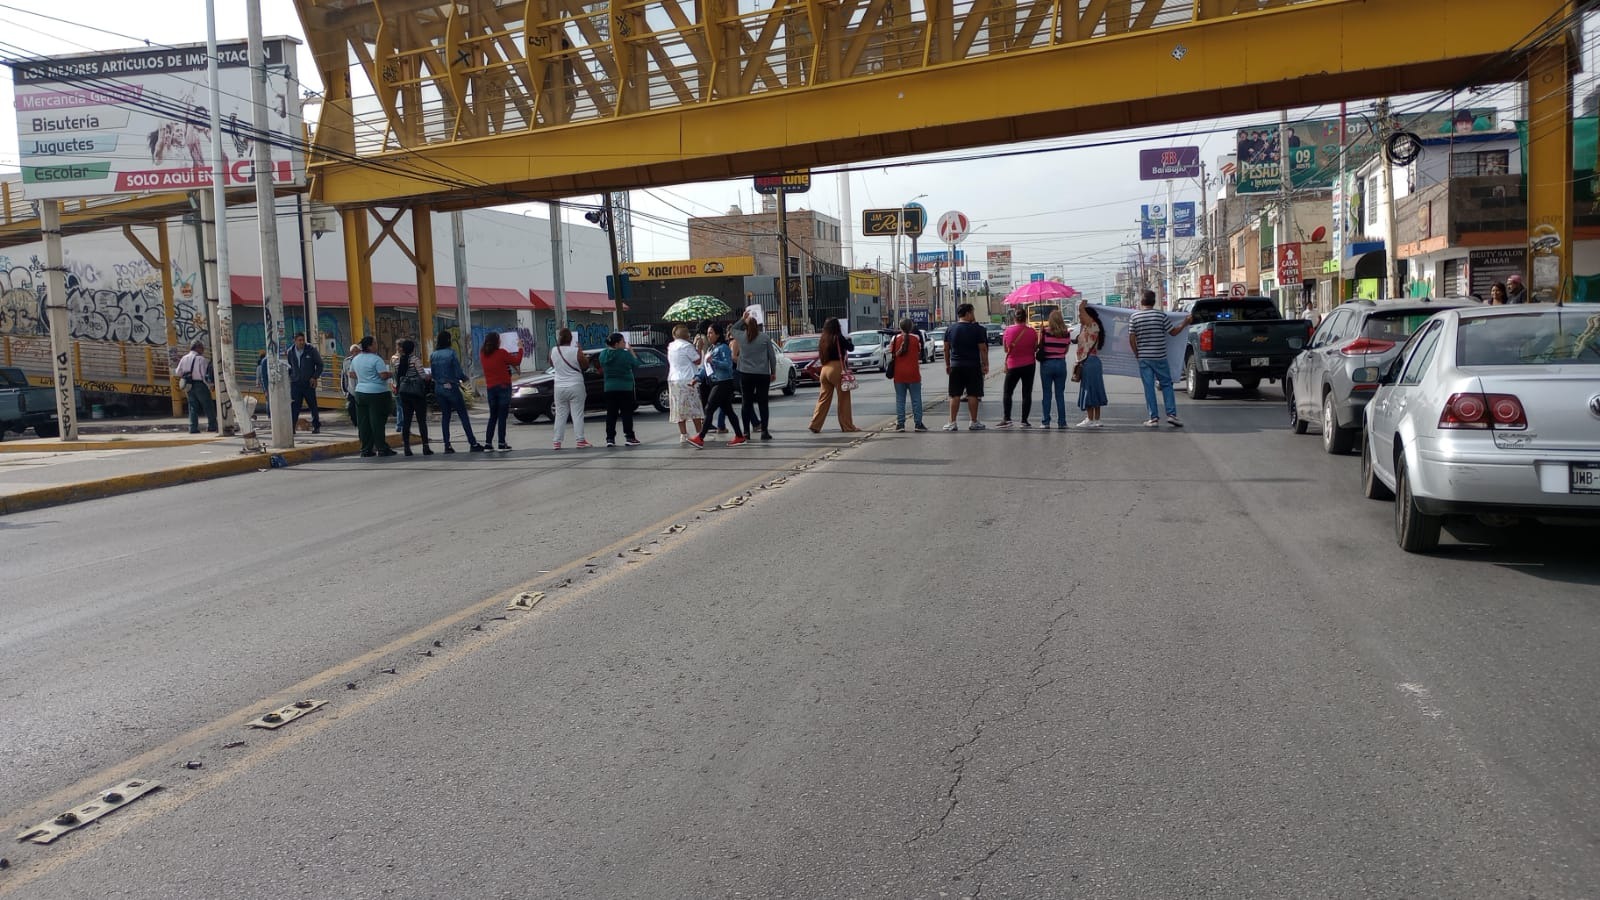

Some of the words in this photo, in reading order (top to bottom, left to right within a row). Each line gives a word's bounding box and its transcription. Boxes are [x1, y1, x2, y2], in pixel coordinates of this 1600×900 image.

[23, 66, 45, 80] LOS
[47, 62, 98, 78] MEJORES
[102, 54, 164, 73] ARTÍCULOS
[167, 54, 184, 67] DE
[185, 47, 271, 66] IMPRTACIN
[22, 91, 86, 109] Mercancía
[32, 114, 99, 132] Bisutería
[32, 137, 94, 155] Juguetes
[1295, 150, 1311, 164] 09
[34, 164, 89, 181] Escolar
[127, 173, 160, 187] SOLO
[163, 168, 195, 184] AQUÍ
[198, 170, 213, 183] EN
[1241, 160, 1282, 182] PESAD
[647, 264, 697, 278] xpertune
